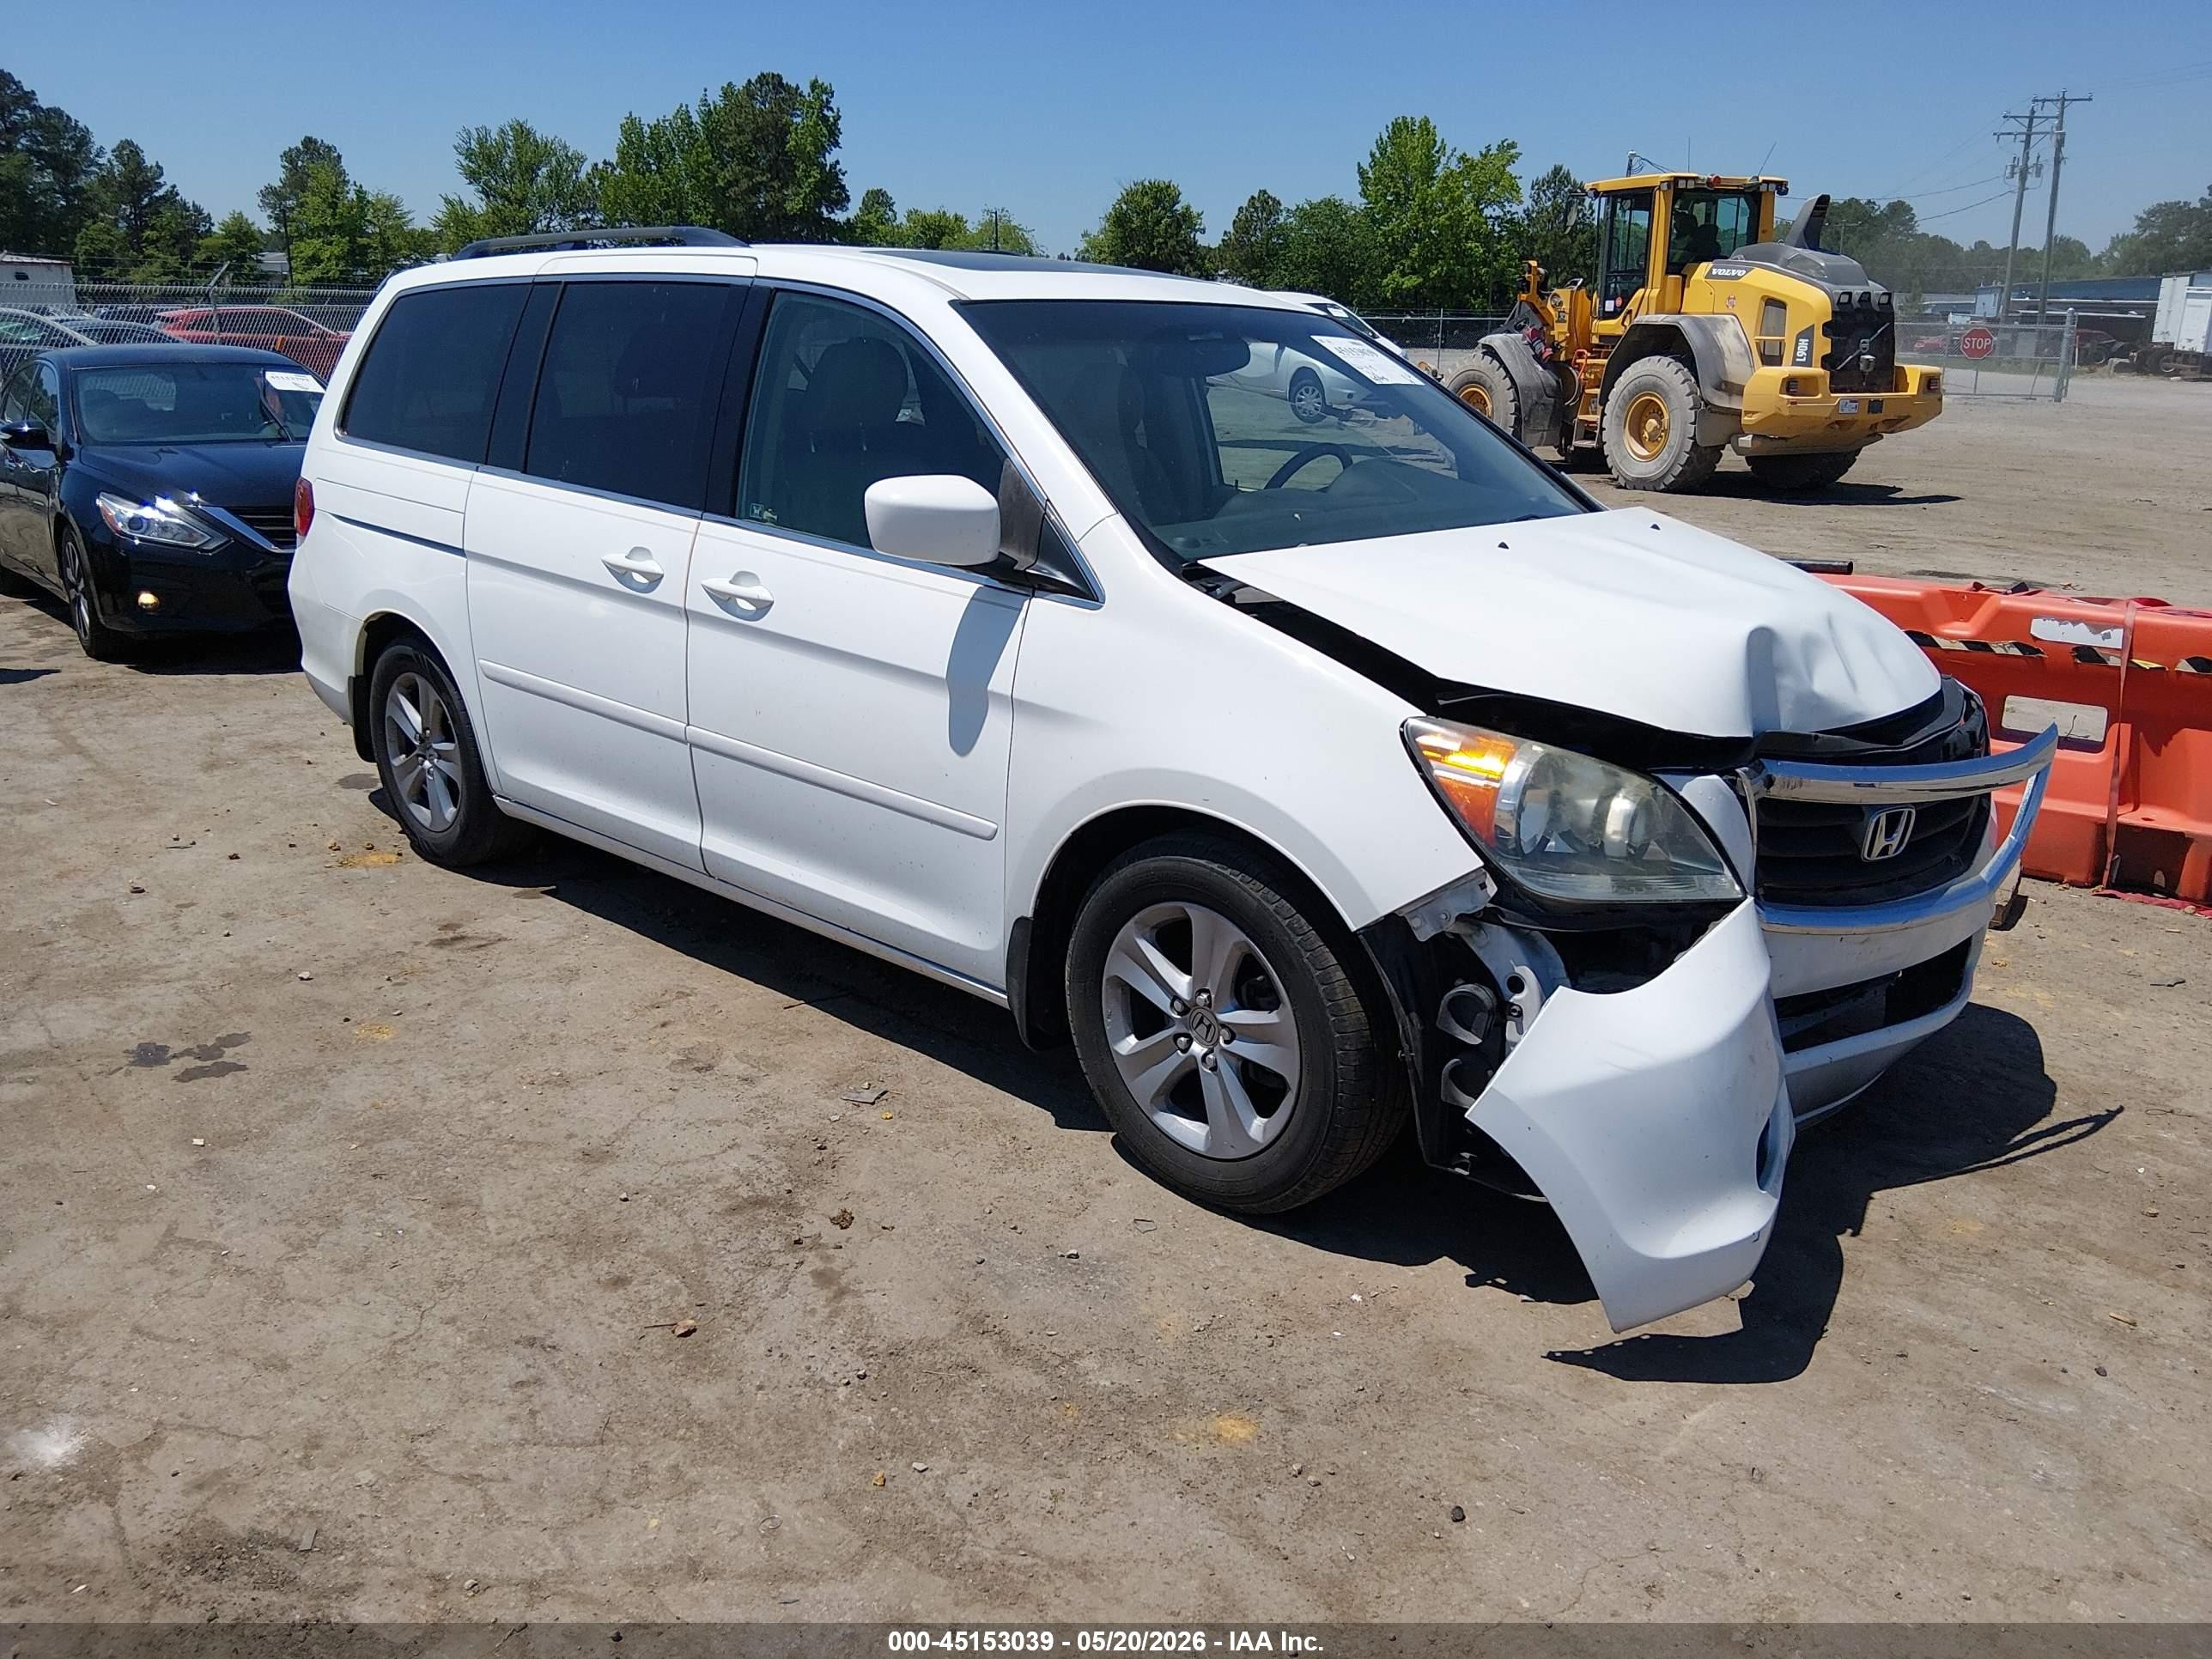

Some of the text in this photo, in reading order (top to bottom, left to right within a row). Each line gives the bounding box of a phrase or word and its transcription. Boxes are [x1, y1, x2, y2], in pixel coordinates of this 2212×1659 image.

[1711, 268, 1747, 276] VOLVO
[1796, 338, 1809, 362] L90H
[1963, 337, 1991, 350] STOP
